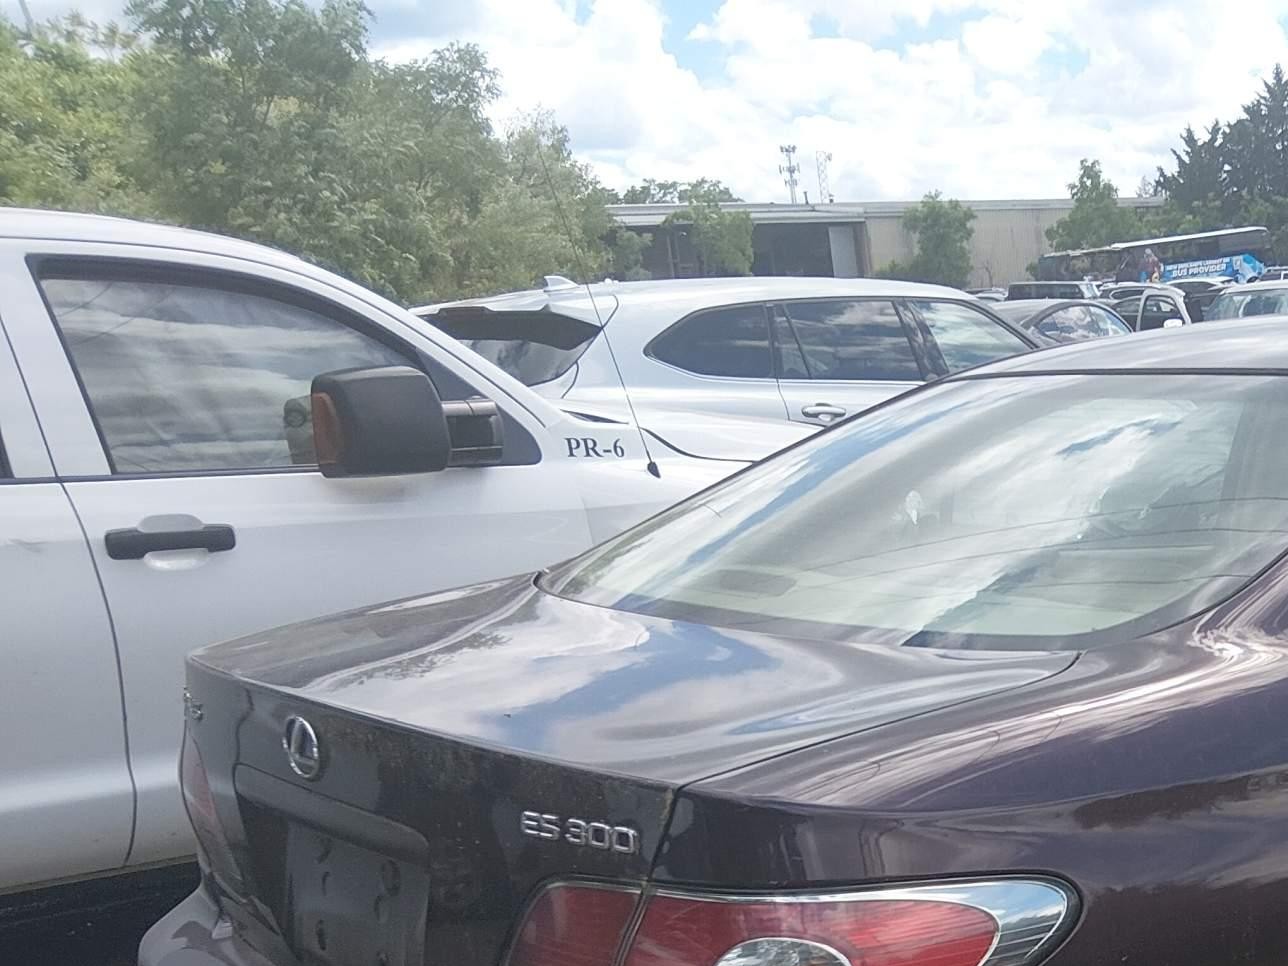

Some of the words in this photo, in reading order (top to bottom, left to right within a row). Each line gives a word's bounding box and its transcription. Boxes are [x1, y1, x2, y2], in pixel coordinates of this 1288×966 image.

[565, 437, 625, 458] PR-6
[521, 810, 561, 840] ES
[564, 818, 639, 854] 300
